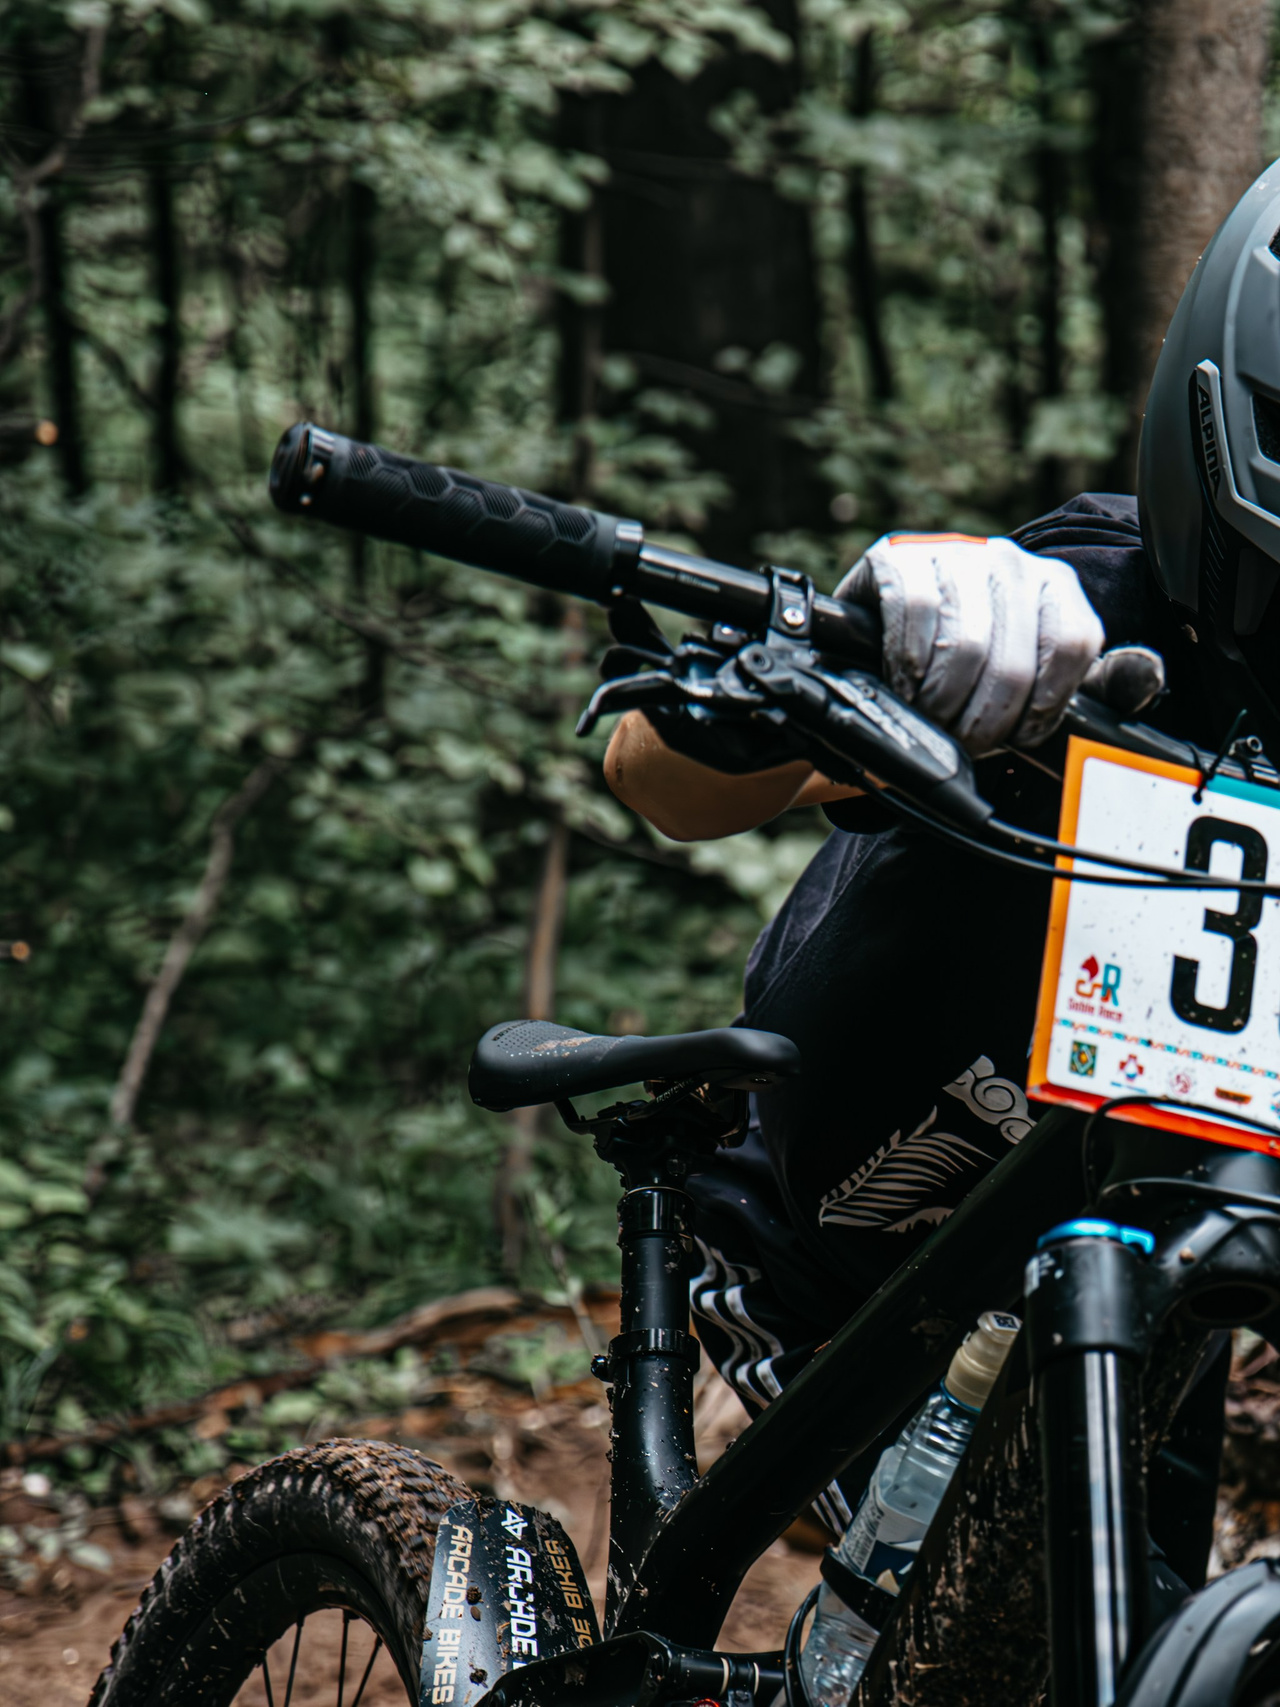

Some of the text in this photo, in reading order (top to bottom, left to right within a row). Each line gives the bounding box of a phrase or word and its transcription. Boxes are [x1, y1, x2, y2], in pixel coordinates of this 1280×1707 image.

[1198, 384, 1221, 500] ALPINA
[431, 1525, 473, 1705] ARCADE BIKES
[544, 1539, 584, 1610] BIKES
